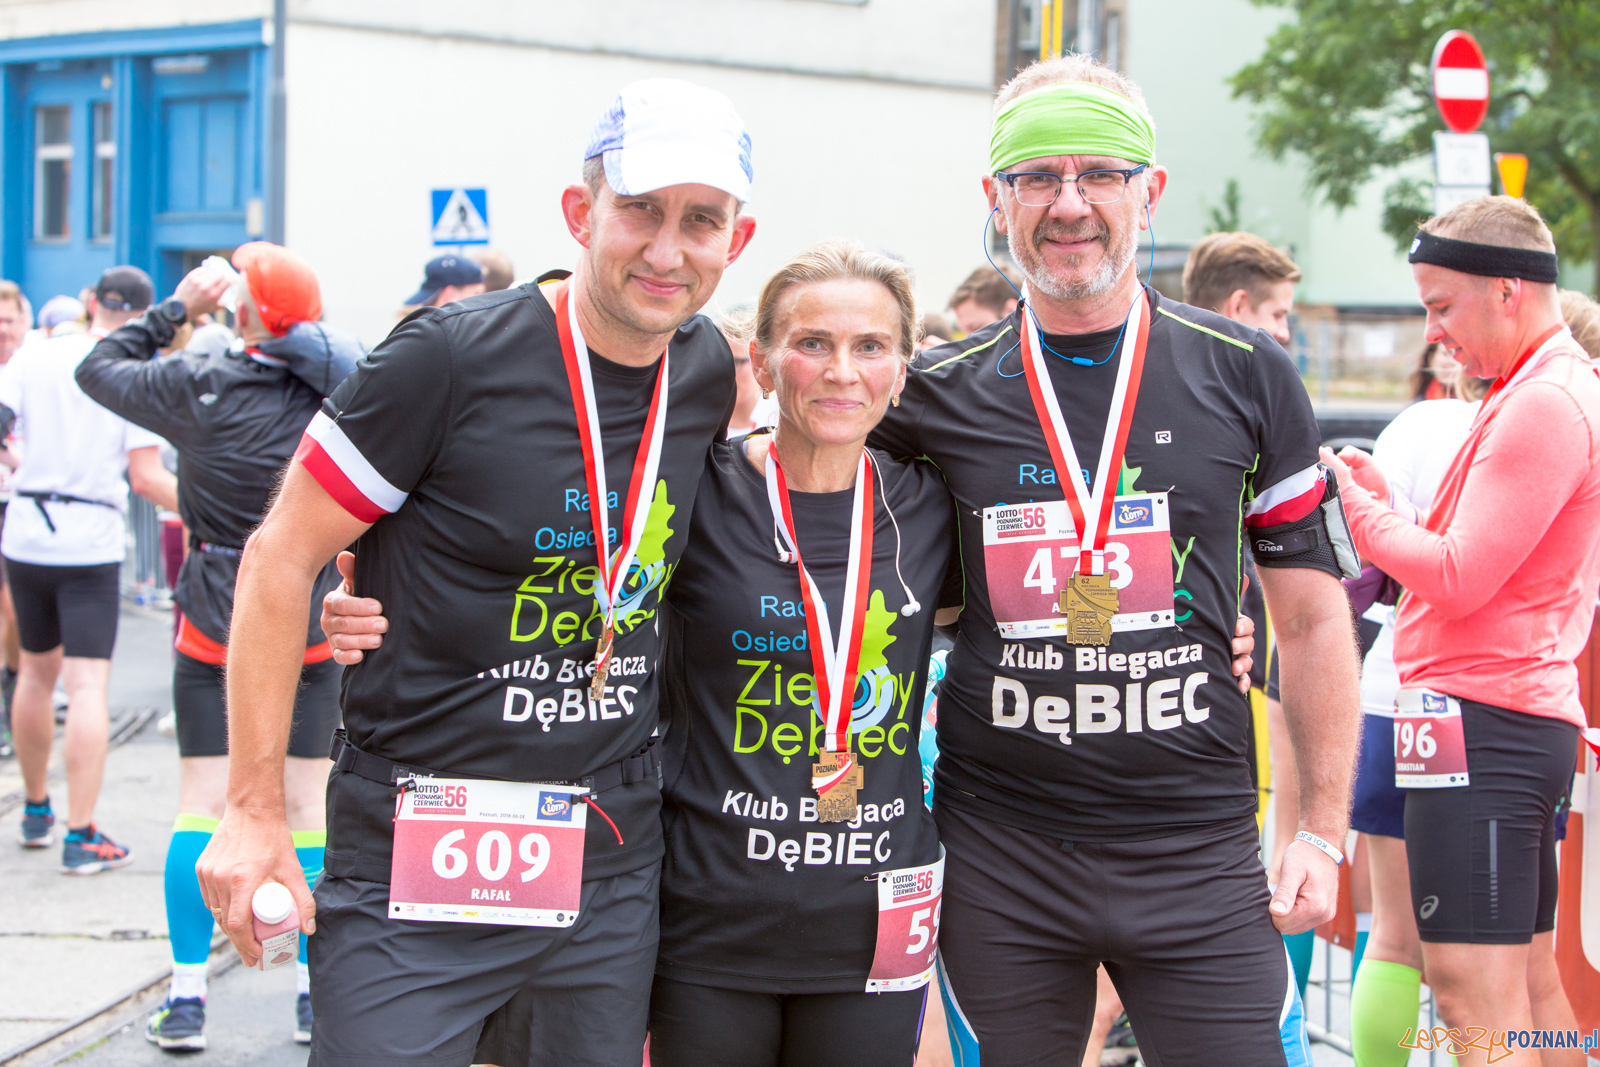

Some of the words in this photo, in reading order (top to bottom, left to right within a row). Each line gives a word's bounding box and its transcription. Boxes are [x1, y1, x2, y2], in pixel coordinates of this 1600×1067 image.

[1019, 463, 1091, 485] Raa
[565, 488, 618, 513] Raa
[996, 509, 1018, 519] LOTTO
[1123, 509, 1144, 521] LOTTO
[997, 523, 1024, 531] CZERWIEC
[1259, 542, 1284, 552] Enea
[1081, 577, 1090, 585] 62
[999, 643, 1064, 671] Klub
[1075, 643, 1203, 680] Biegacza
[556, 655, 647, 684] Bieacza
[503, 685, 639, 732] DęBIEC
[992, 671, 1210, 745] DęBIEC
[815, 763, 838, 774] POZNAŃ
[414, 784, 440, 794] LOTTO
[413, 799, 444, 807] CZERWIEC
[546, 802, 565, 813] LOTTO
[721, 790, 789, 822] Klub
[431, 828, 551, 883] 609
[747, 828, 892, 872] DęBIEC
[892, 873, 914, 885] LOTTO
[471, 888, 512, 901] RAFAŁ
[892, 887, 917, 897] CZERWIEC
